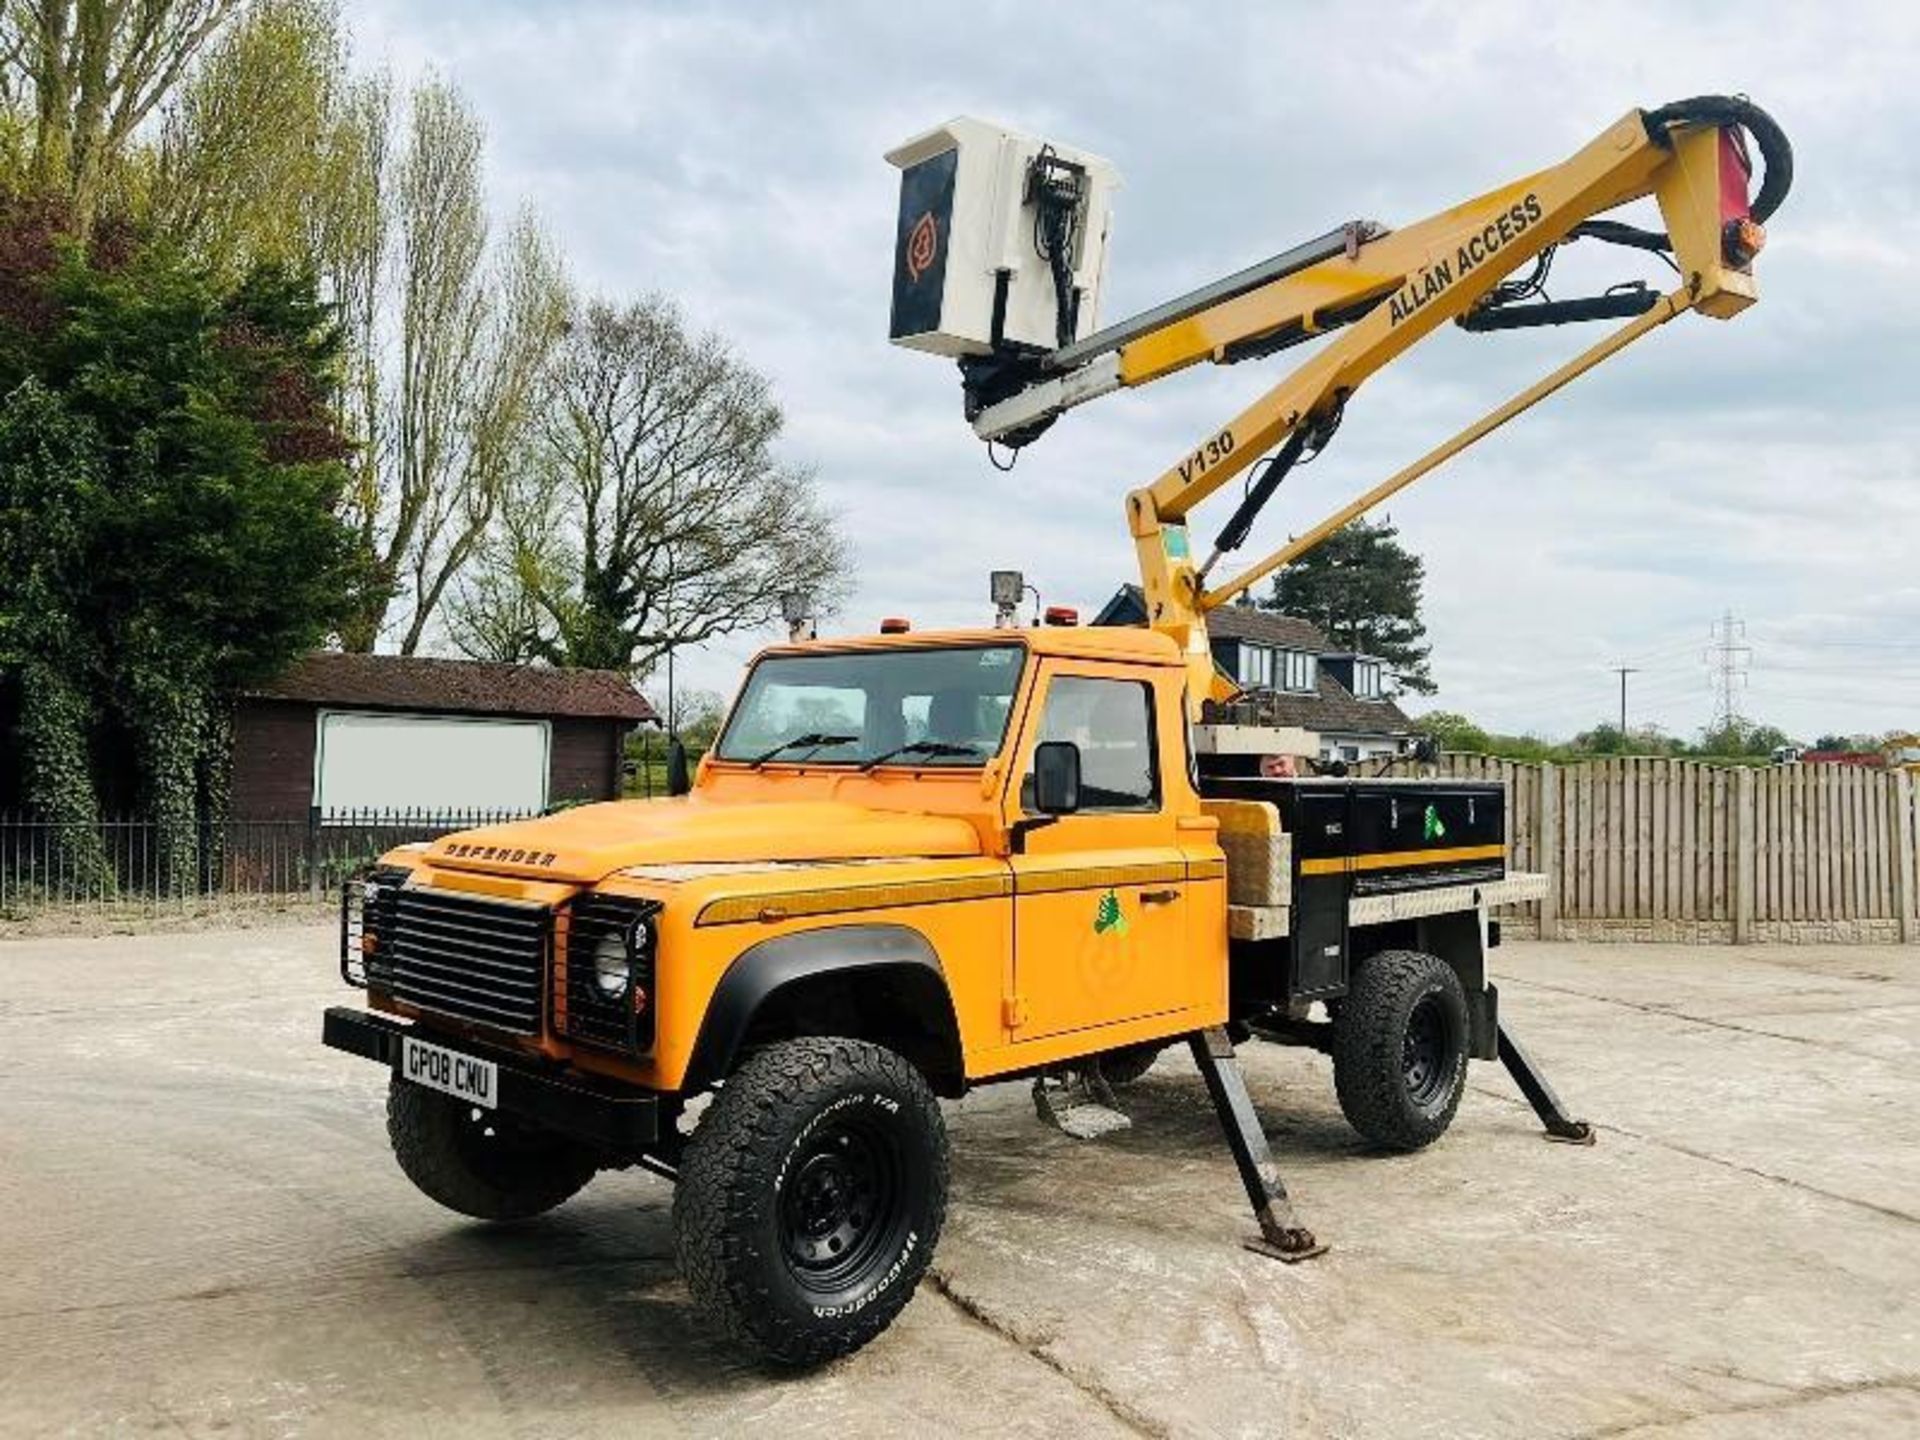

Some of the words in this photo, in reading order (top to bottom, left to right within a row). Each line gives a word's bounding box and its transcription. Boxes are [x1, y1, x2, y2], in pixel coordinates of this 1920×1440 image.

[1389, 260, 1453, 327] ALLAN
[1457, 194, 1542, 276] ACCESS
[1178, 430, 1234, 484] V130
[444, 844, 557, 867] DEFENDER
[410, 1044, 450, 1085] GP08
